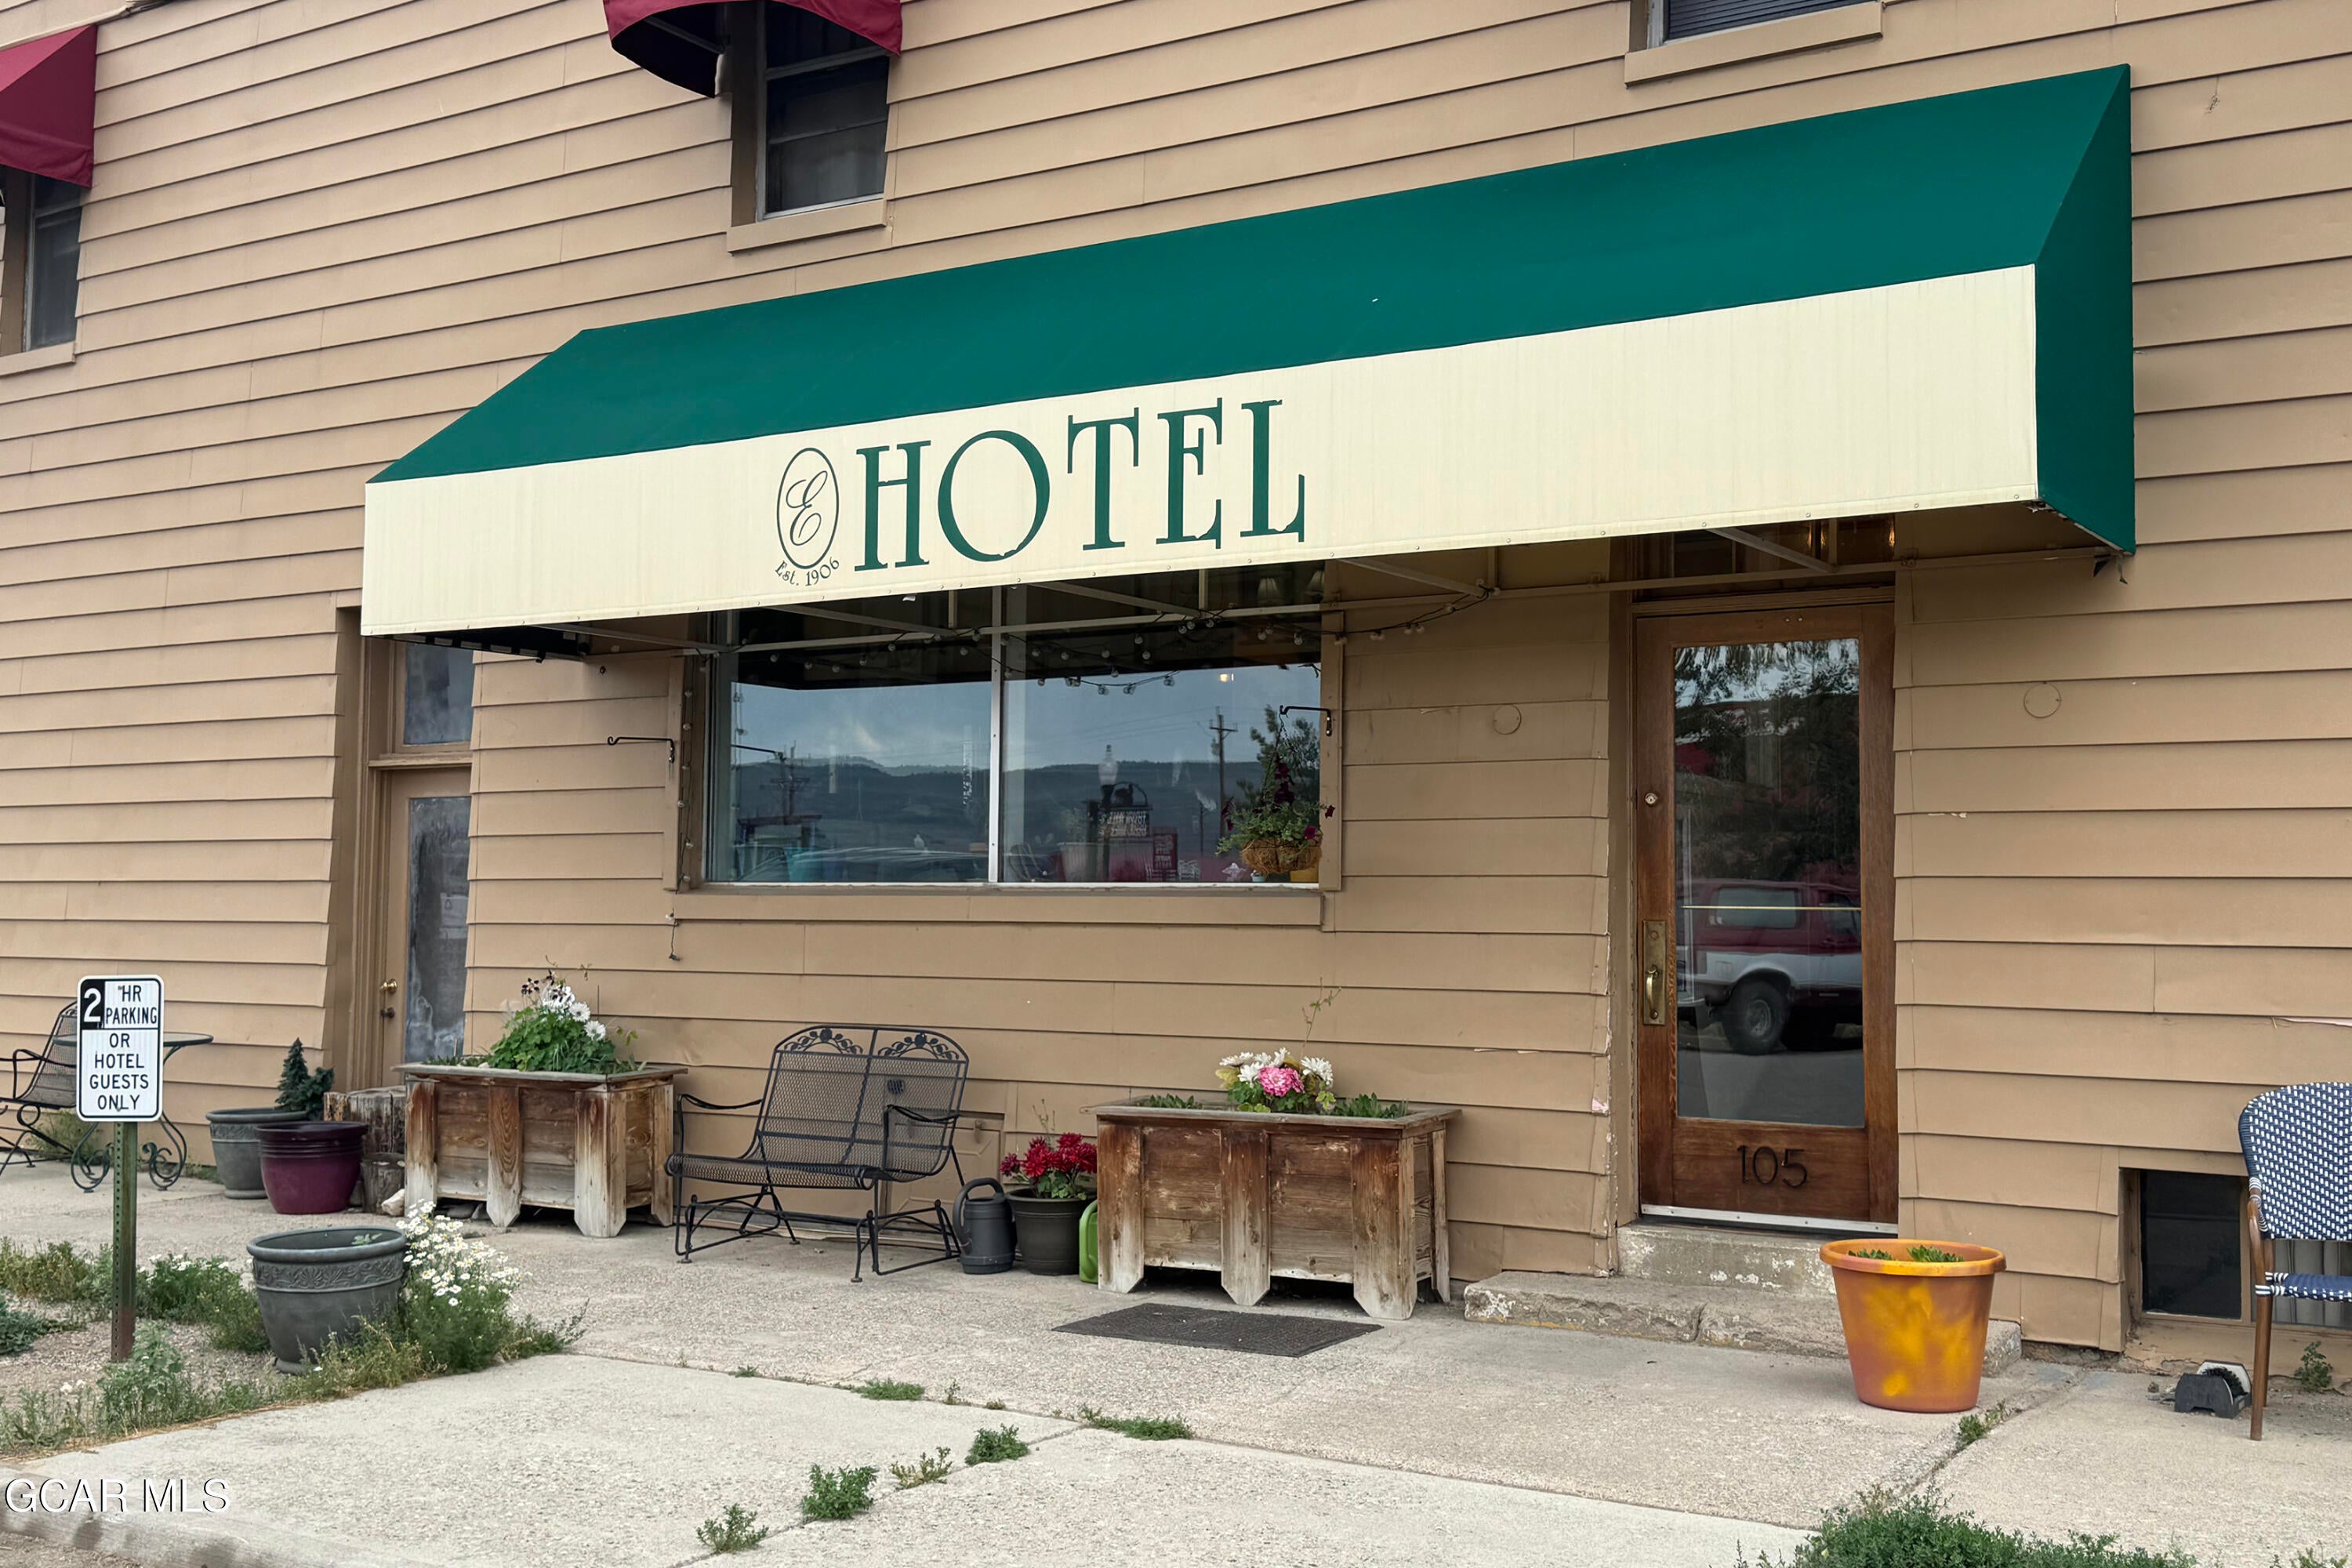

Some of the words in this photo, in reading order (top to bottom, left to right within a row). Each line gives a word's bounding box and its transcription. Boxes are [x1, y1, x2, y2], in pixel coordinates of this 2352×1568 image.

[855, 397, 1305, 572] HOTEL
[786, 470, 828, 546] E
[775, 560, 800, 586] Est.
[805, 557, 840, 586] 1906
[83, 988, 101, 1022] 2
[122, 985, 141, 1002] HR
[106, 1007, 157, 1024] PARKING
[109, 1033, 130, 1047] OR
[95, 1053, 145, 1069] HOTEL
[89, 1074, 149, 1089] GUESTS
[97, 1094, 140, 1110] ONLY
[1737, 1145, 1808, 1188] 105
